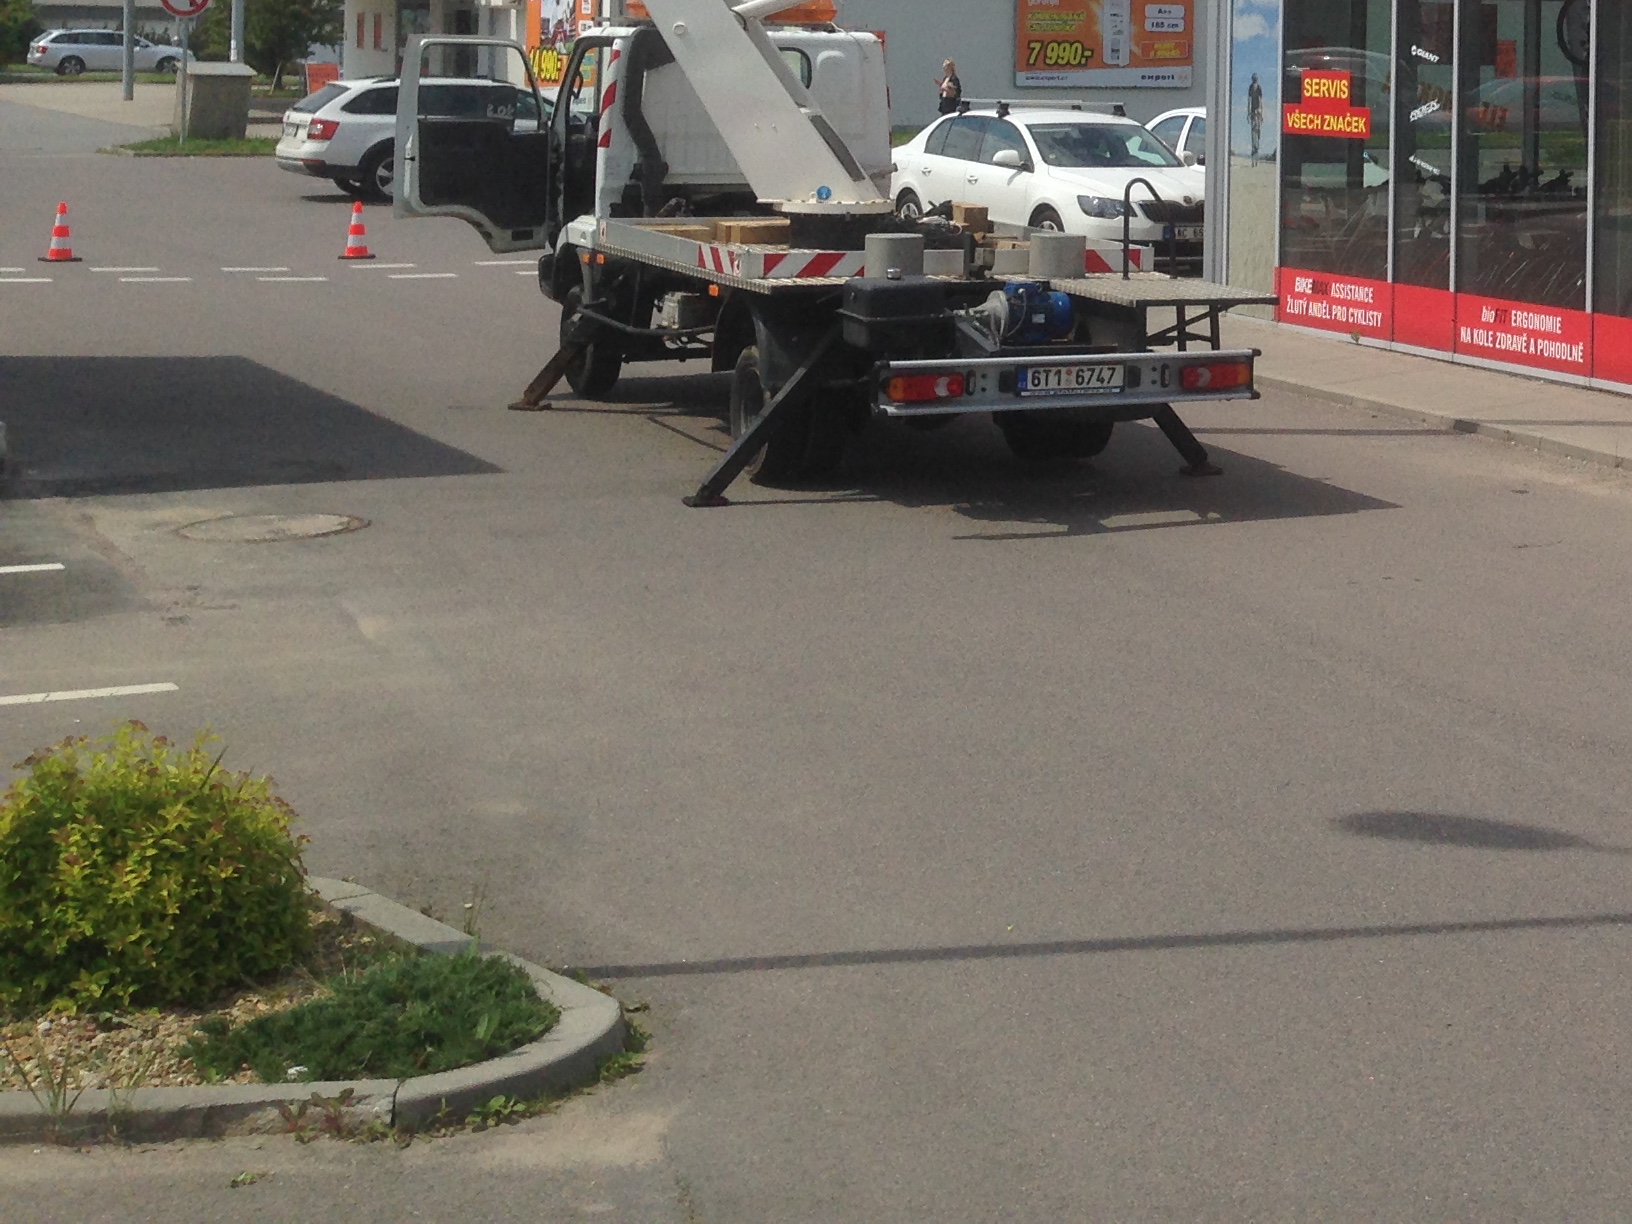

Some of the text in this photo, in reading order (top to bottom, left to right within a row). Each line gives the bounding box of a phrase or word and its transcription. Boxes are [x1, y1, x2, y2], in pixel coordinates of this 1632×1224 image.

[1028, 41, 1042, 65] 7
[1304, 78, 1349, 99] SERVIS
[1287, 109, 1366, 133] VŠECH ZNAČEK
[1331, 282, 1374, 304] ASSISTANCE
[1286, 295, 1382, 328] ŽLUTÝ ANDĚL PRO CYKLISTY
[1511, 309, 1562, 334] ERGONOMIE
[1460, 326, 1472, 343] NA
[1473, 328, 1493, 347] KOLE
[1529, 338, 1535, 355] A
[1537, 339, 1584, 363] POHODLNĚ
[1031, 367, 1117, 388] 6T1 6747
